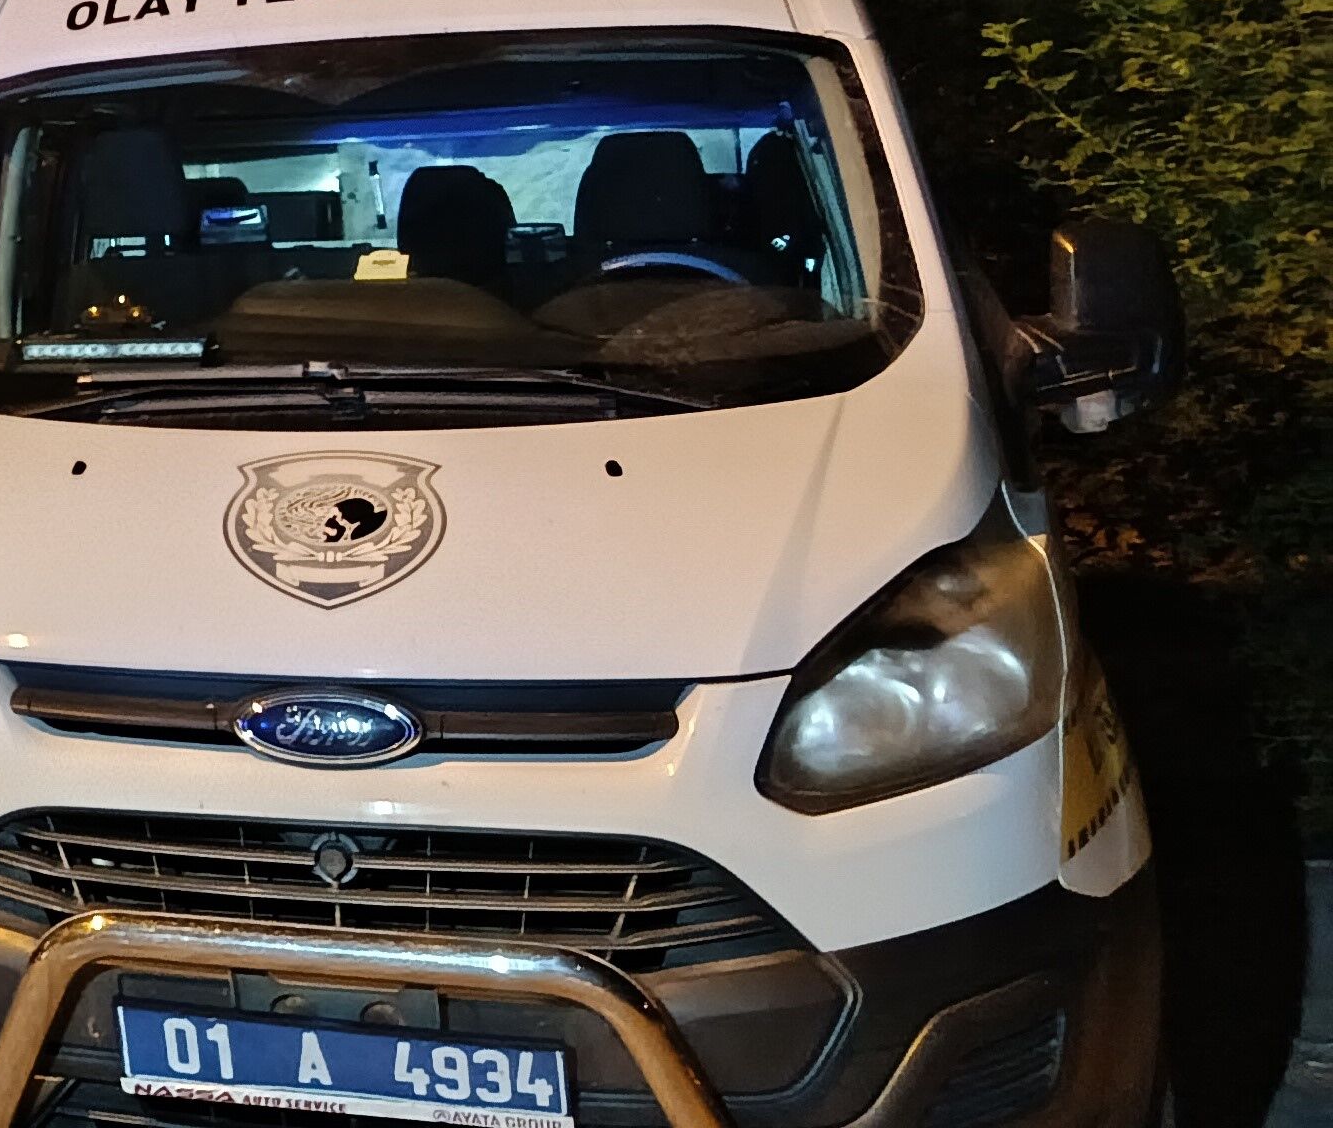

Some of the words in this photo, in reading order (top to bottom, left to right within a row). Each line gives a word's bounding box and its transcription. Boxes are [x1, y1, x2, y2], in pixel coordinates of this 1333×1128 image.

[162, 1016, 234, 1080] 01
[297, 1030, 333, 1086] A
[393, 1040, 554, 1107] 4934
[452, 1111, 501, 1127] AYATA
